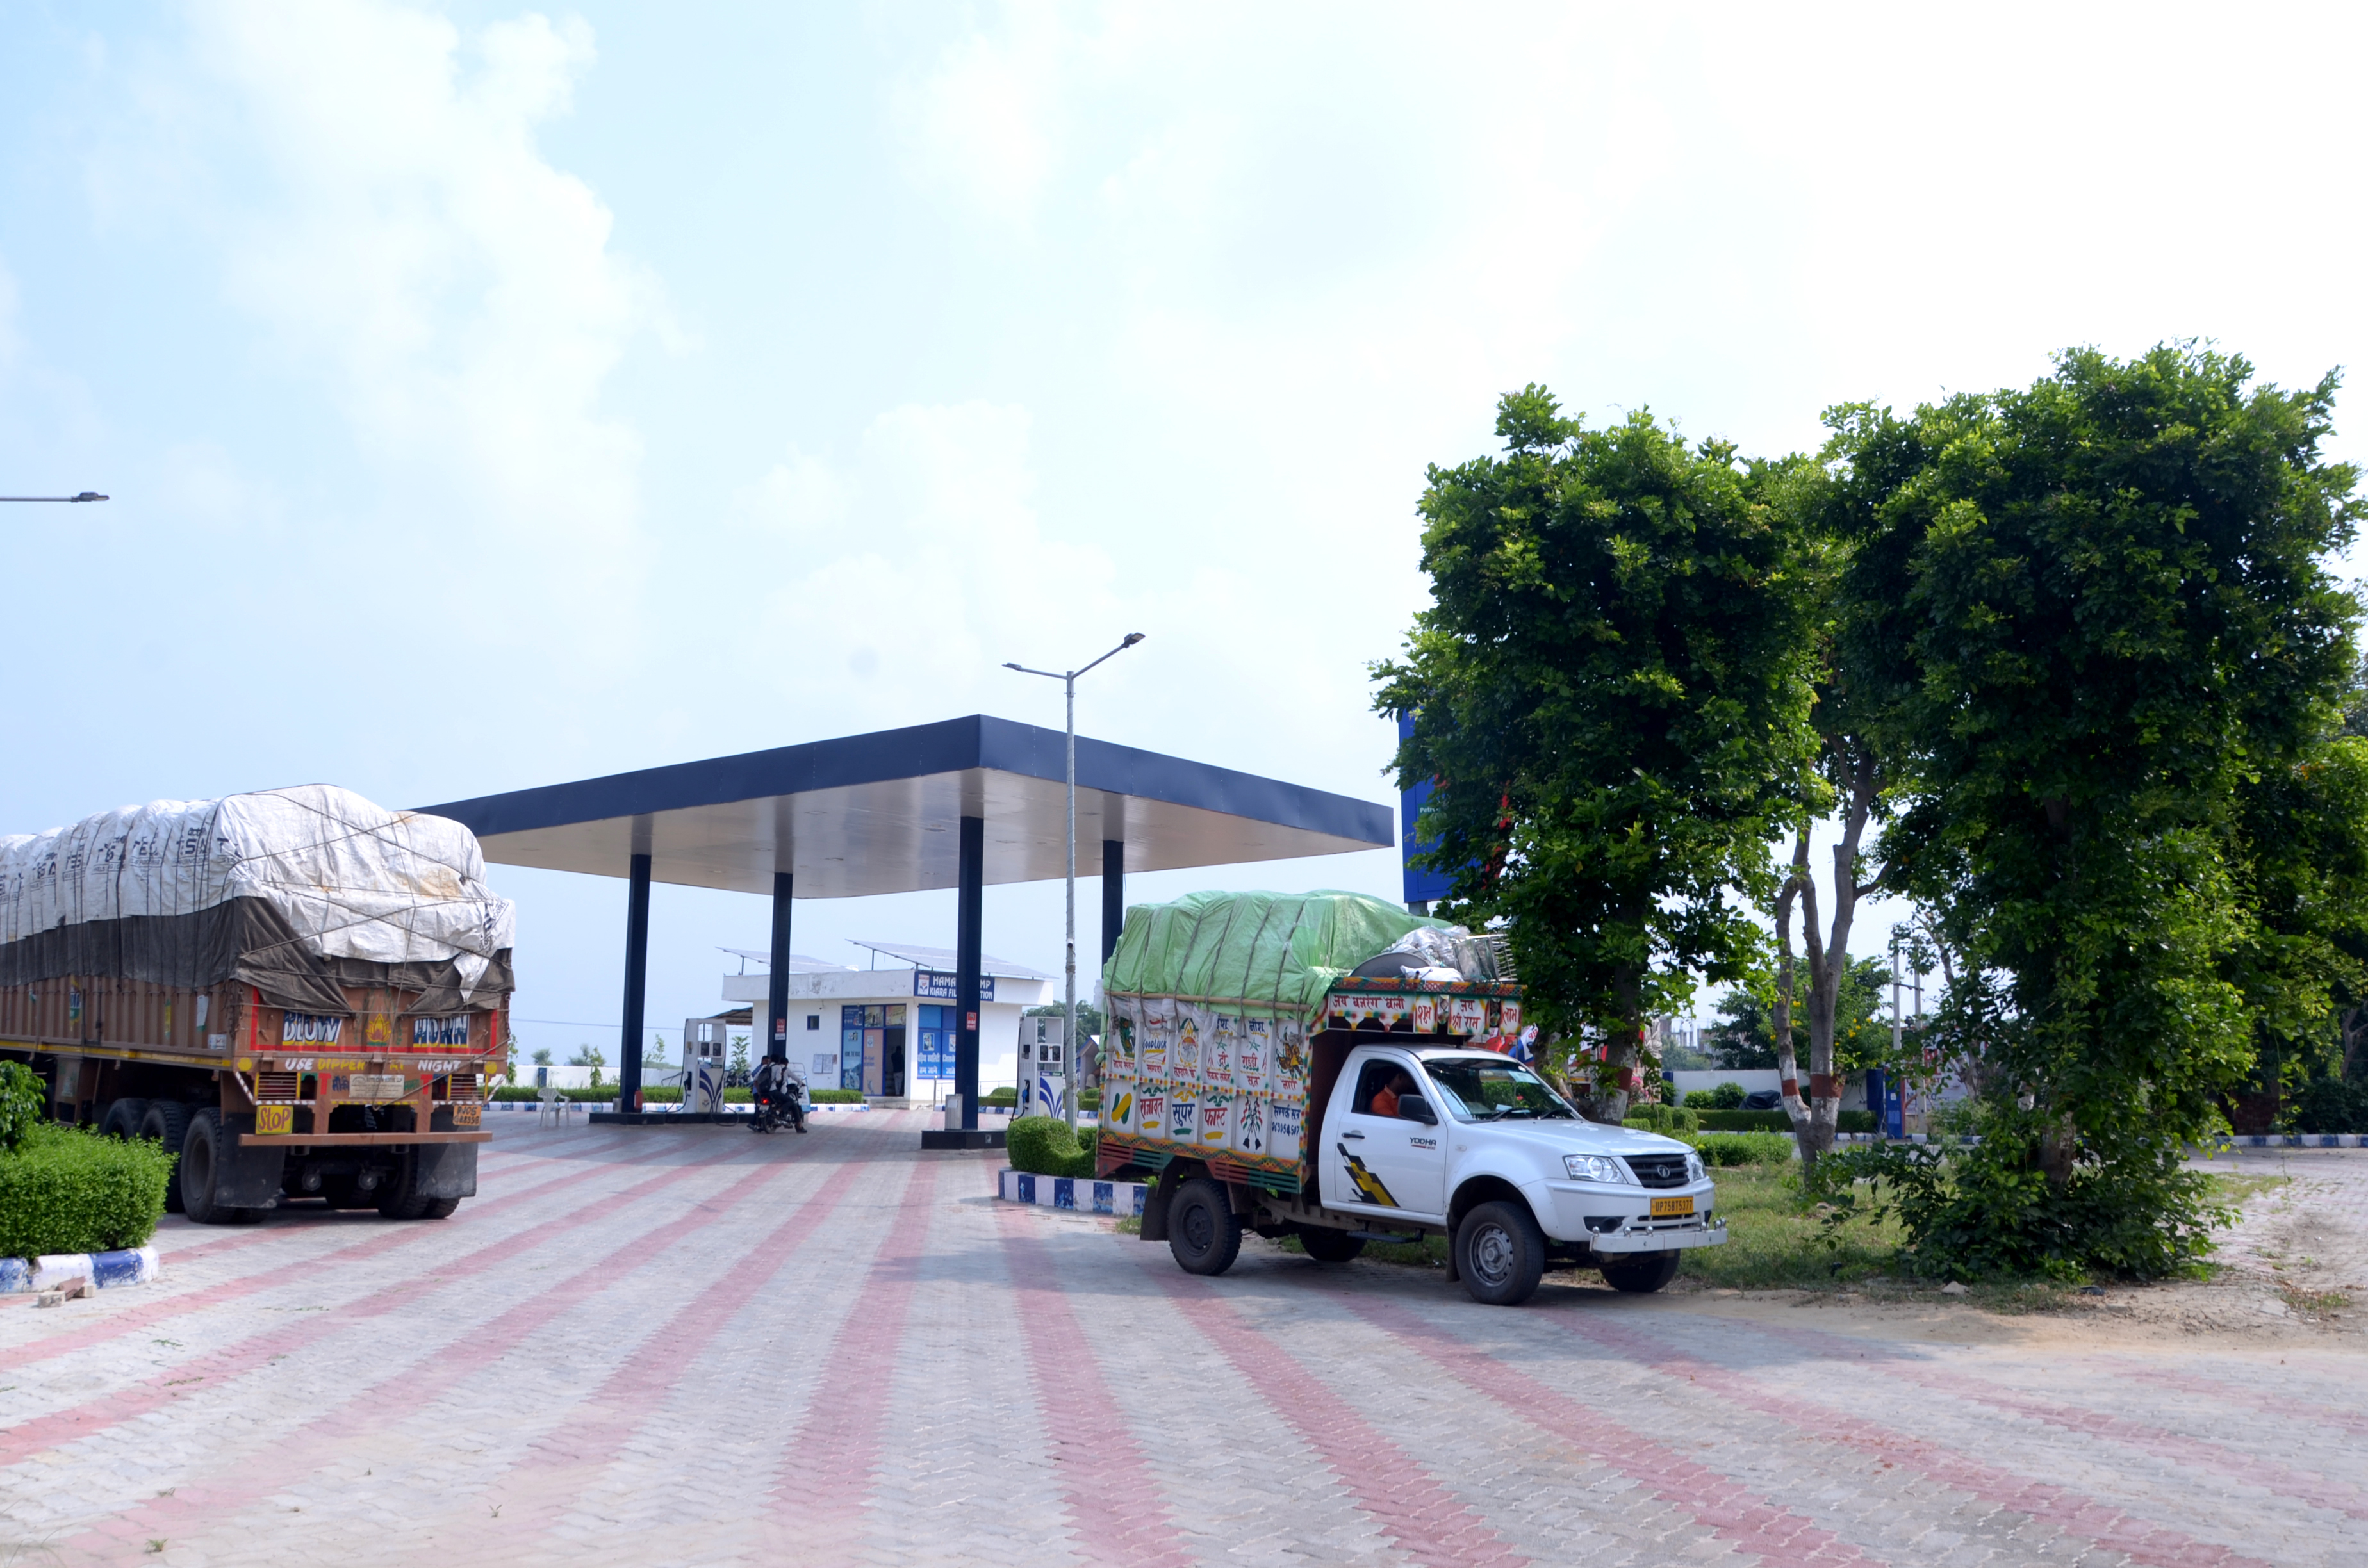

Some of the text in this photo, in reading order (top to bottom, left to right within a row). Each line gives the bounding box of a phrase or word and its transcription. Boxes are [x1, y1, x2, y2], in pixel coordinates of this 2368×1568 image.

[933, 976, 957, 987] HAMA
[930, 987, 947, 997] KIARA
[980, 990, 993, 1000] TION
[1460, 999, 1476, 1013] जय
[1418, 1005, 1433, 1025] शुभ
[1502, 1007, 1517, 1026] लाभ
[282, 1010, 343, 1046] BLOW
[413, 1014, 469, 1048] HORN
[1463, 1015, 1482, 1032] राम
[285, 1058, 313, 1071] USE
[317, 1059, 366, 1070] DIPPER
[418, 1059, 461, 1072] NIGHT
[1410, 1136, 1437, 1146] YODHA
